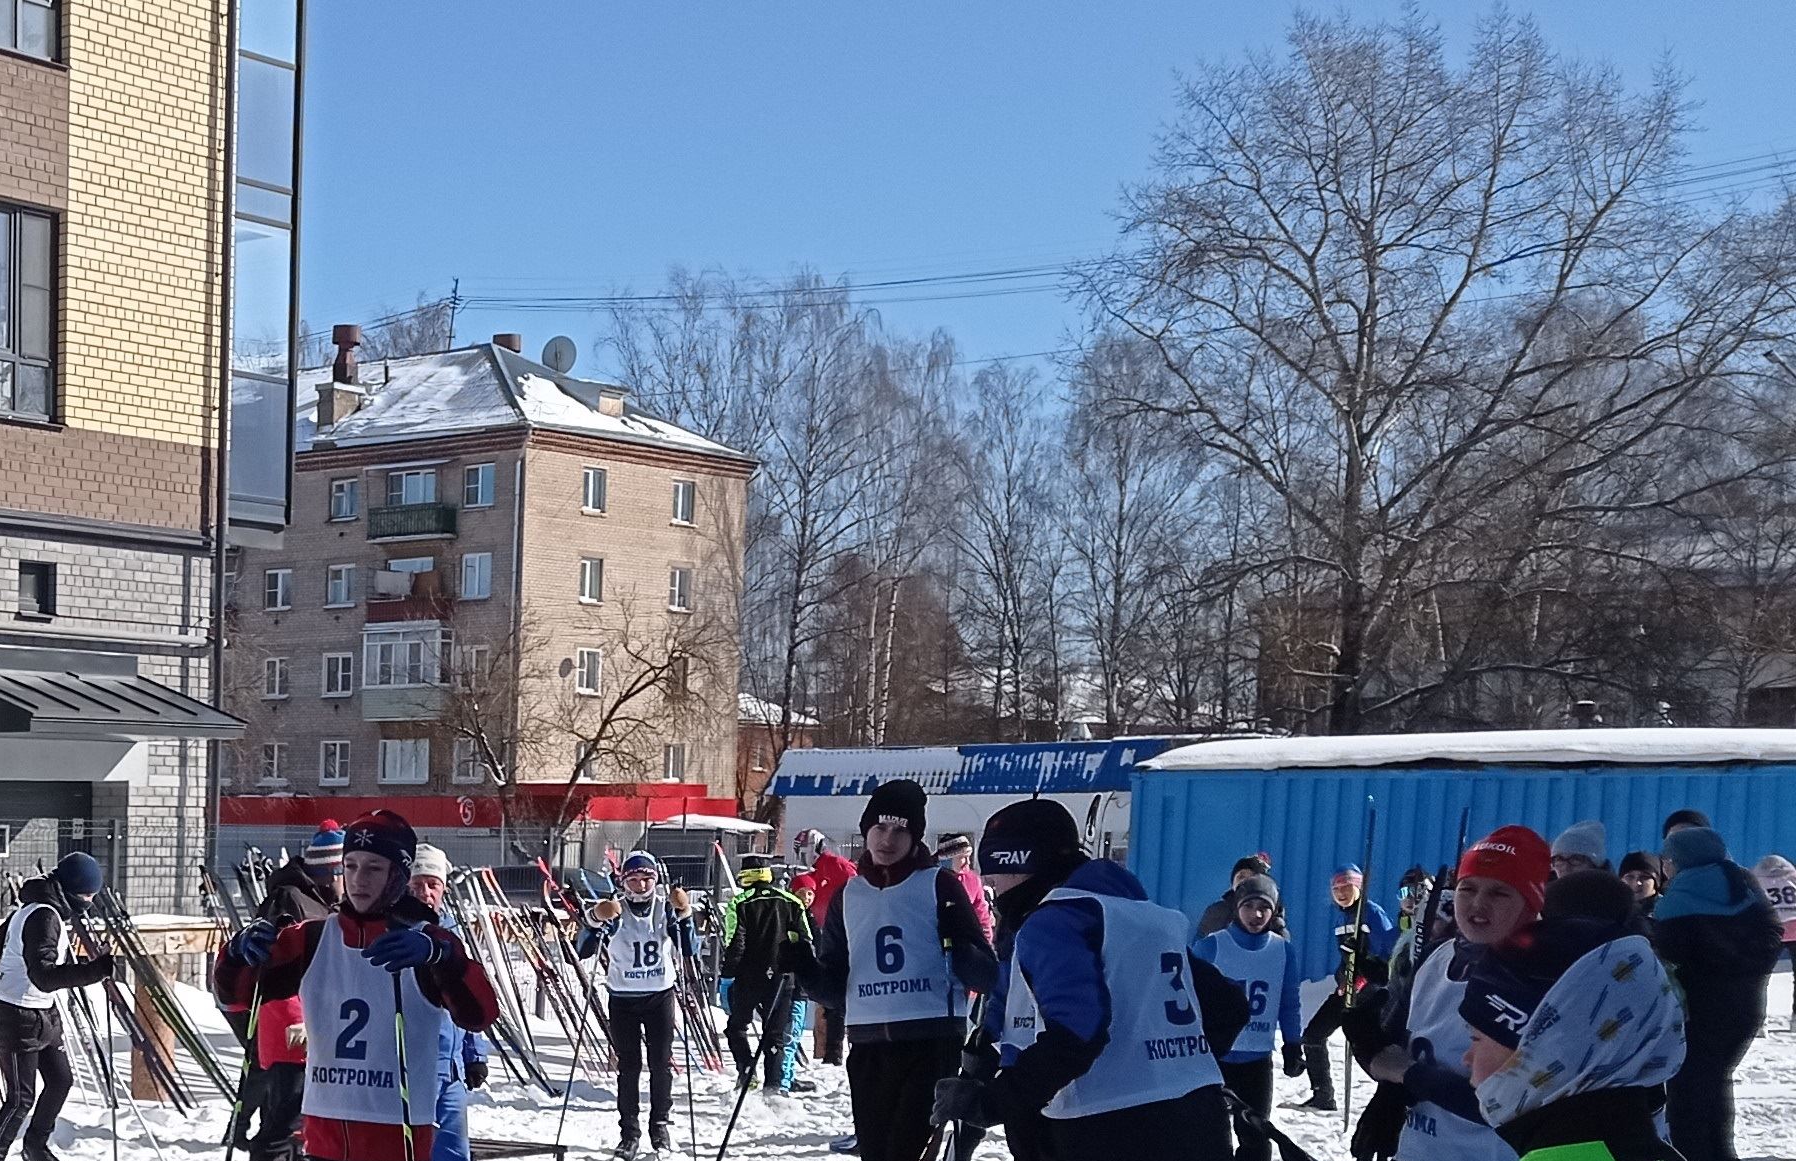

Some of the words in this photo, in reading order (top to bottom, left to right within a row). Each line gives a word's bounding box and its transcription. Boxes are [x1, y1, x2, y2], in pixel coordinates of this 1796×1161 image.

[633, 940, 660, 969] 18
[875, 925, 905, 974] 6
[858, 978, 933, 998] КОСТРОМА
[1160, 952, 1197, 1026] 3
[335, 998, 371, 1061] 2
[1145, 1034, 1209, 1061] КОСТРО
[311, 1066, 394, 1089] КОСТРОМА
